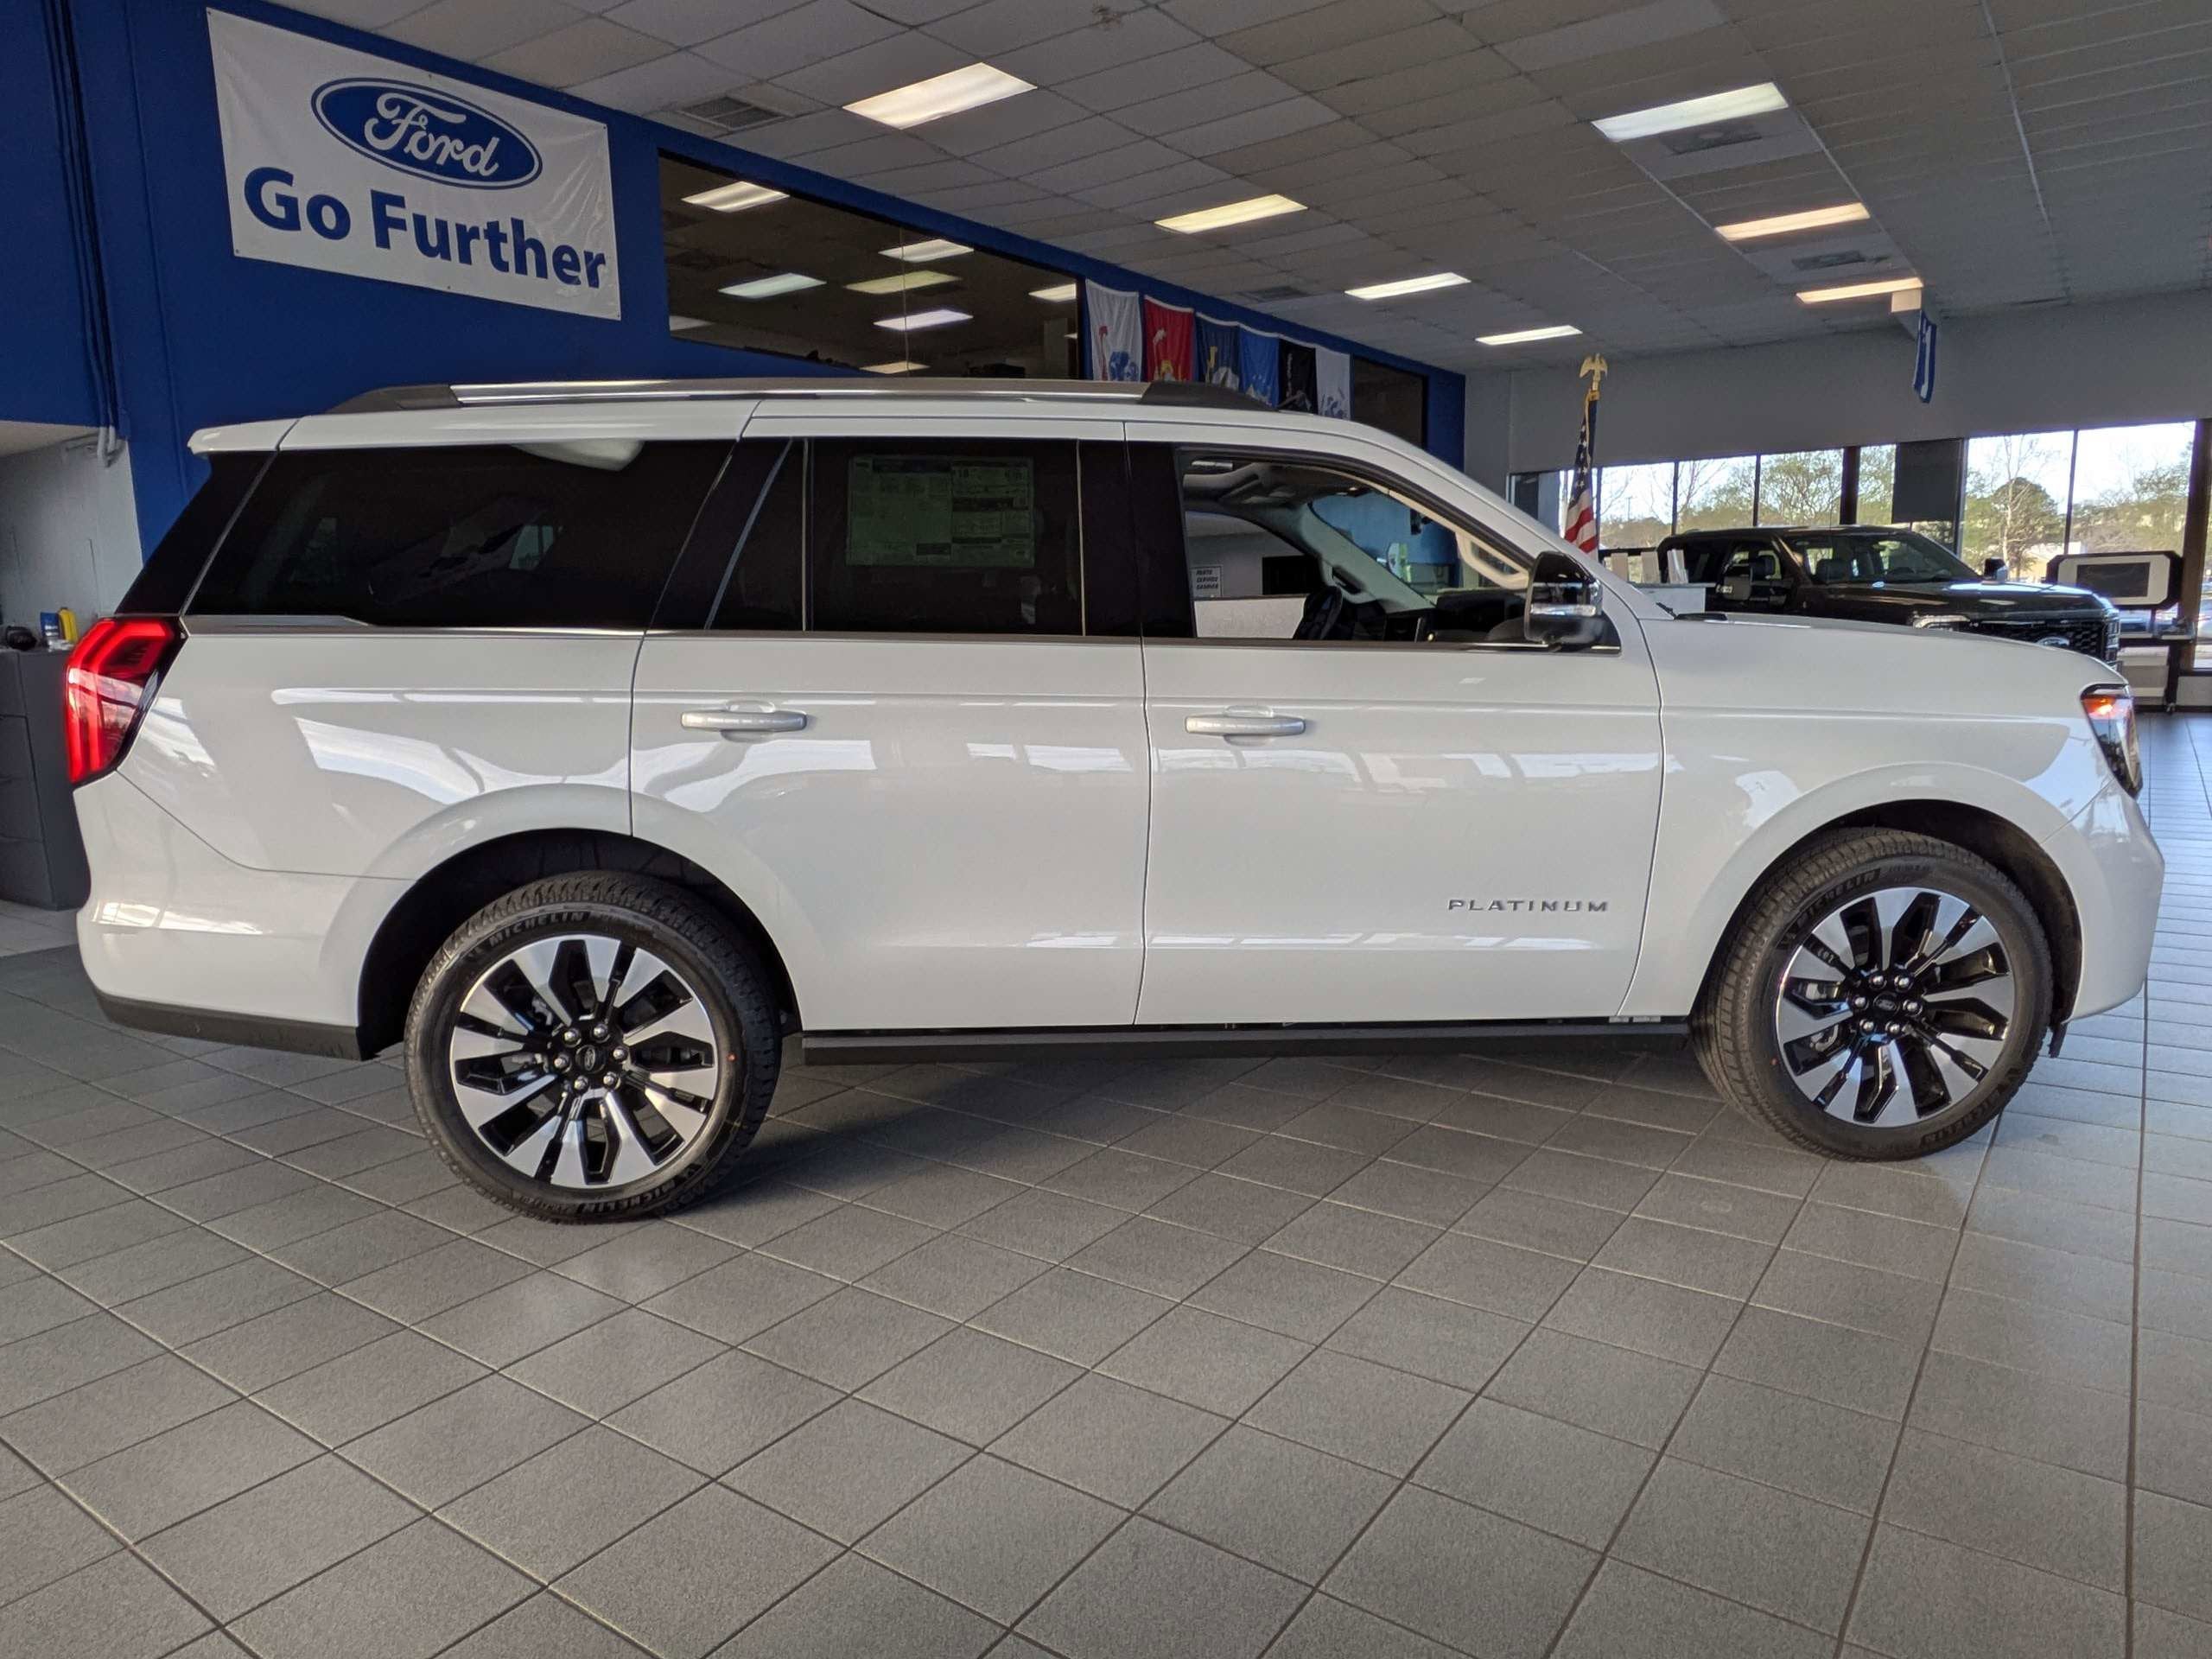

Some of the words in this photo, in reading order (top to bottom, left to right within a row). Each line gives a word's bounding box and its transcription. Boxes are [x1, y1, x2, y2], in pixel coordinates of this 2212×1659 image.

[364, 92, 499, 177] Ford
[244, 166, 351, 241] Go
[370, 189, 606, 289] Further
[489, 912, 584, 947] MICHELIN
[1448, 899, 1608, 912] PLATINUM
